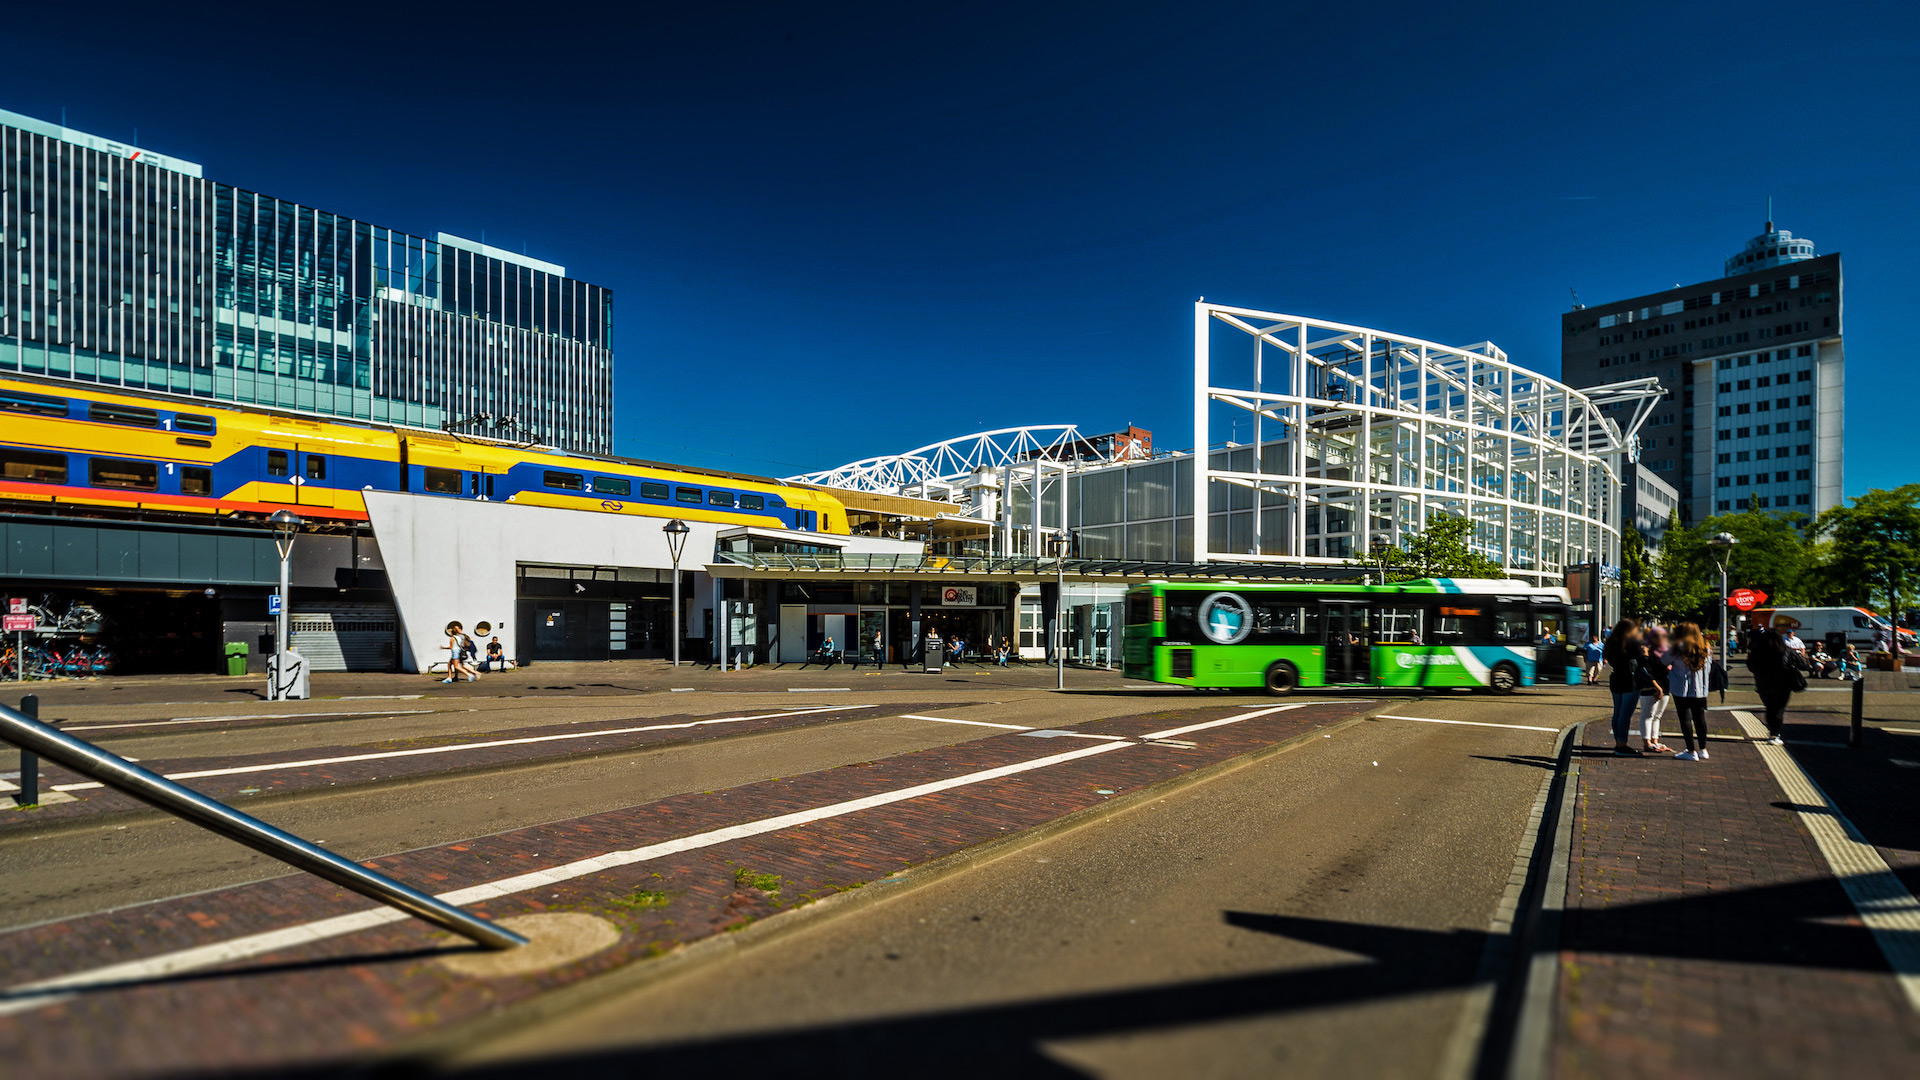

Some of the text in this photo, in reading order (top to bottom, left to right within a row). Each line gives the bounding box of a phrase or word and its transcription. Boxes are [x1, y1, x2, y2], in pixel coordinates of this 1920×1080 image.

[163, 419, 171, 431] 1
[165, 463, 173, 475] 1
[585, 483, 592, 493] 2
[734, 500, 740, 509] 2
[272, 597, 281, 607] P
[1736, 595, 1754, 604] store
